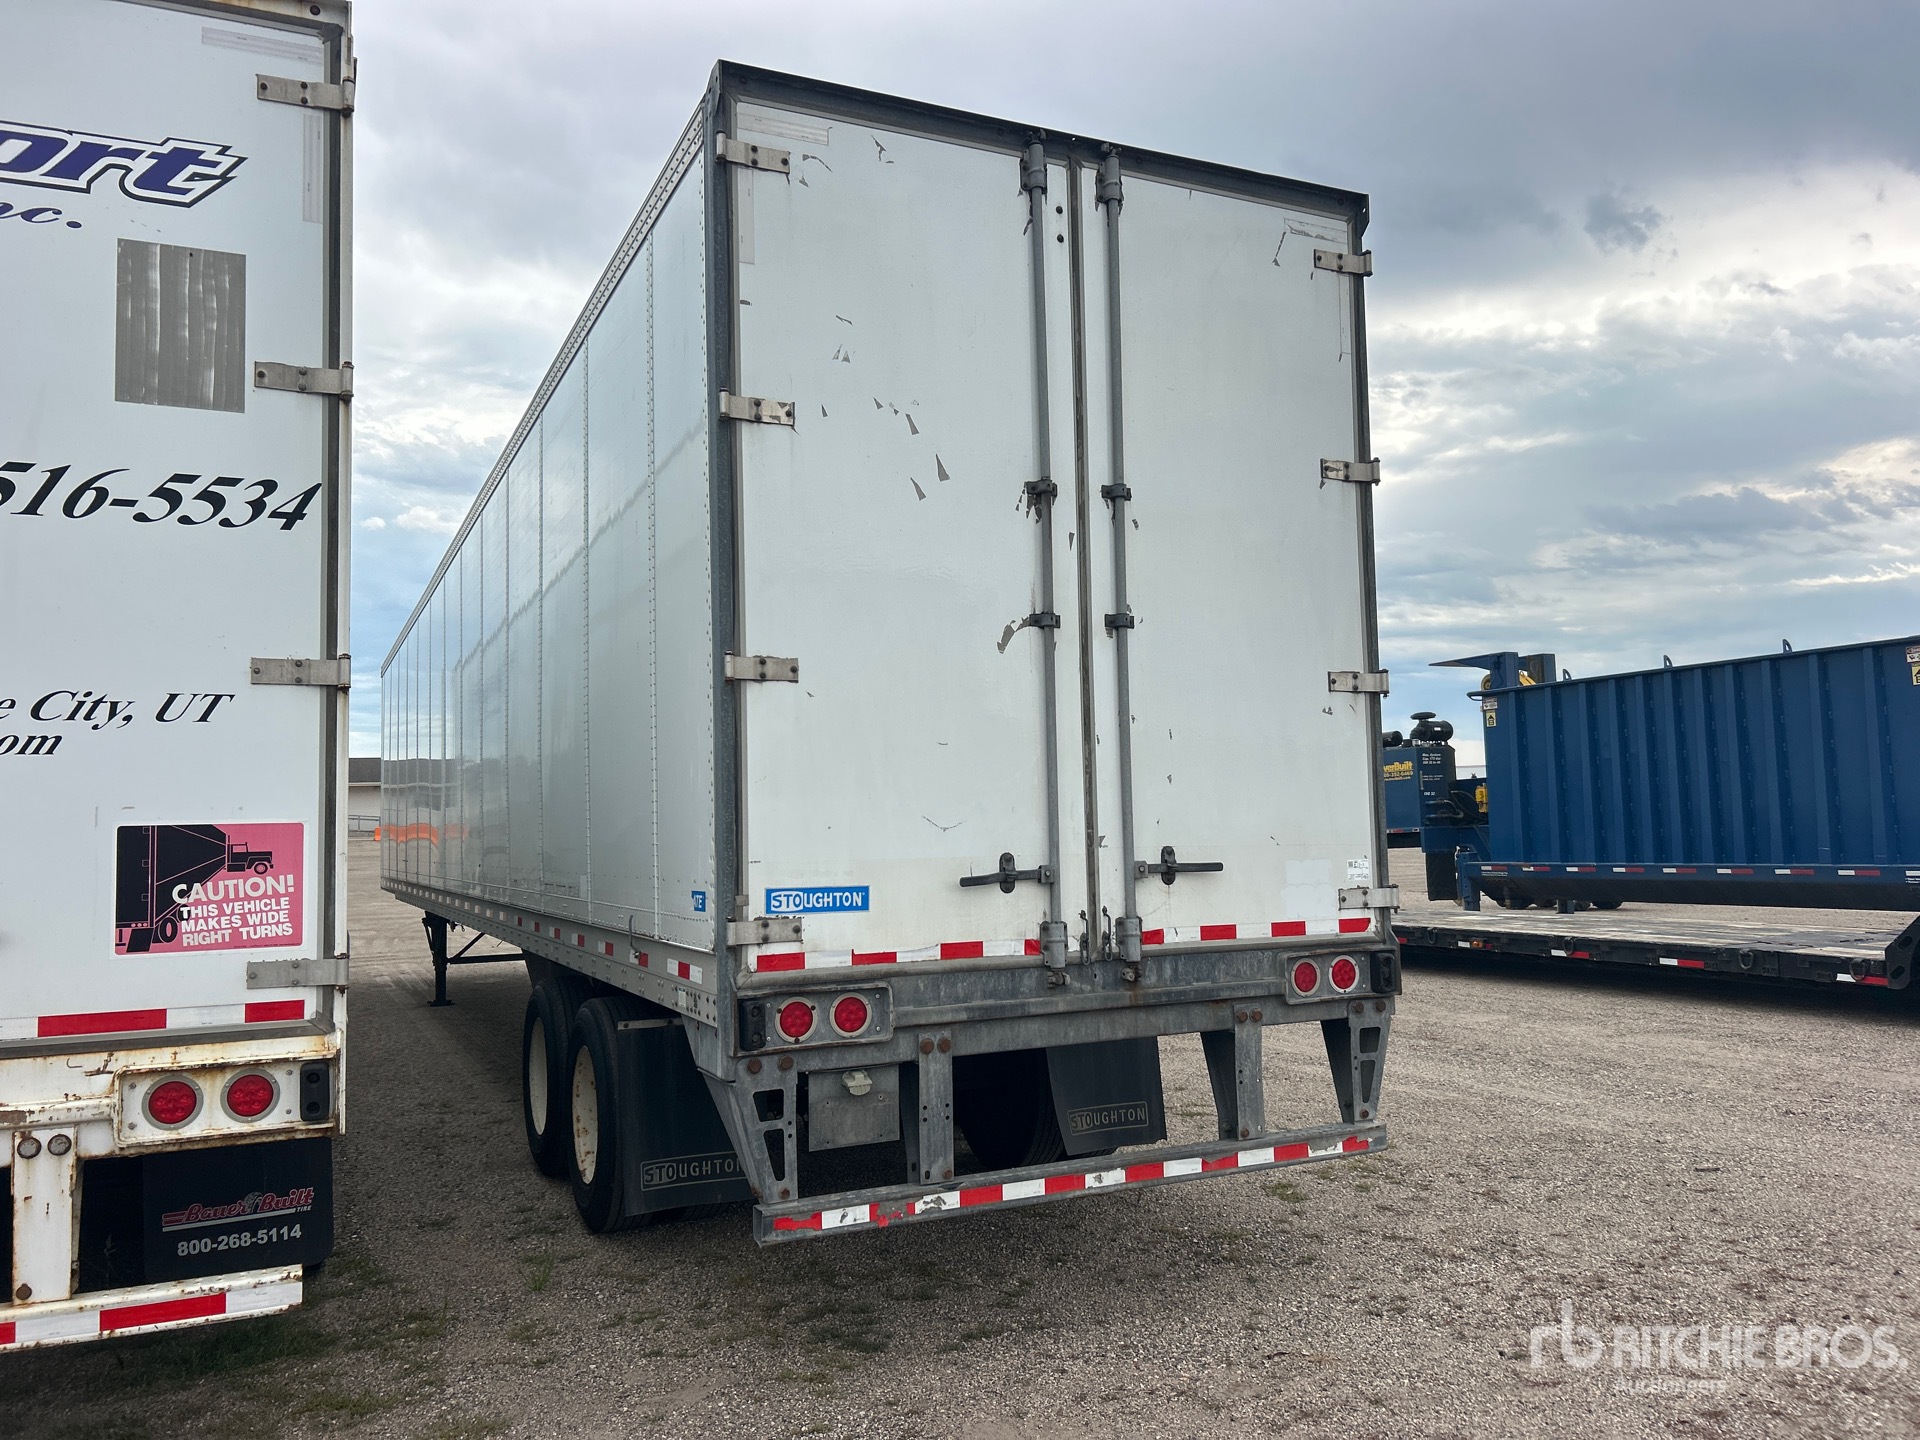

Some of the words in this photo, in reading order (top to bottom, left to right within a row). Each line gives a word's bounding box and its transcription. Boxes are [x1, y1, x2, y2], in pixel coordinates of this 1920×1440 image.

[29, 690, 135, 730] City,
[155, 692, 235, 723] UT
[172, 874, 294, 904] CAUTION!
[180, 904, 218, 919] THIS
[222, 897, 290, 915] VEHICLE
[181, 915, 242, 933] MAKES
[246, 910, 289, 926] WIDE
[182, 929, 232, 947] RIGHT
[239, 923, 293, 940] TURNS
[1070, 1108, 1145, 1131] STOUGHTON
[183, 1200, 250, 1223] Bauer
[258, 1187, 314, 1213] Built
[297, 1205, 311, 1213] TIRE
[177, 1223, 302, 1257] 800-268-5114
